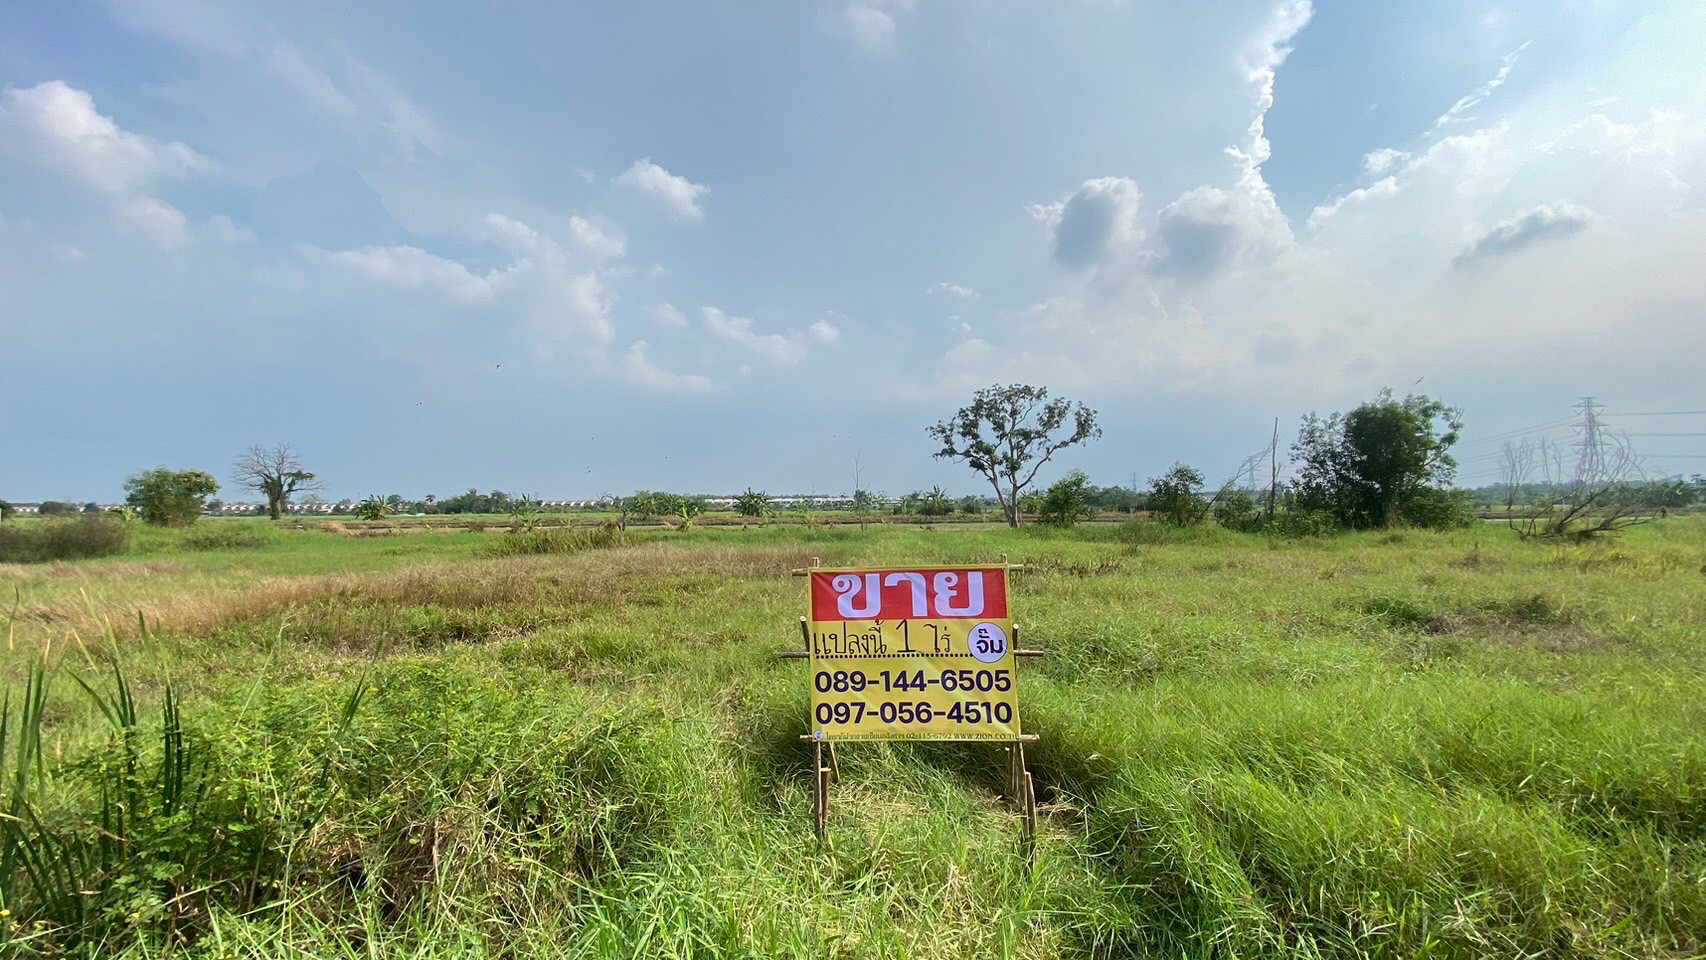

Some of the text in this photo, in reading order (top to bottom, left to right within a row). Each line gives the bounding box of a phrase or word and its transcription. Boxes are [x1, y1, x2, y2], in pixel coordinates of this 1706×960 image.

[831, 571, 985, 618] ขาย
[813, 618, 951, 655] แปลงนี้ 1 ไร่
[814, 669, 1012, 693] 089-144-6505
[815, 701, 1013, 725] 097-056-4510
